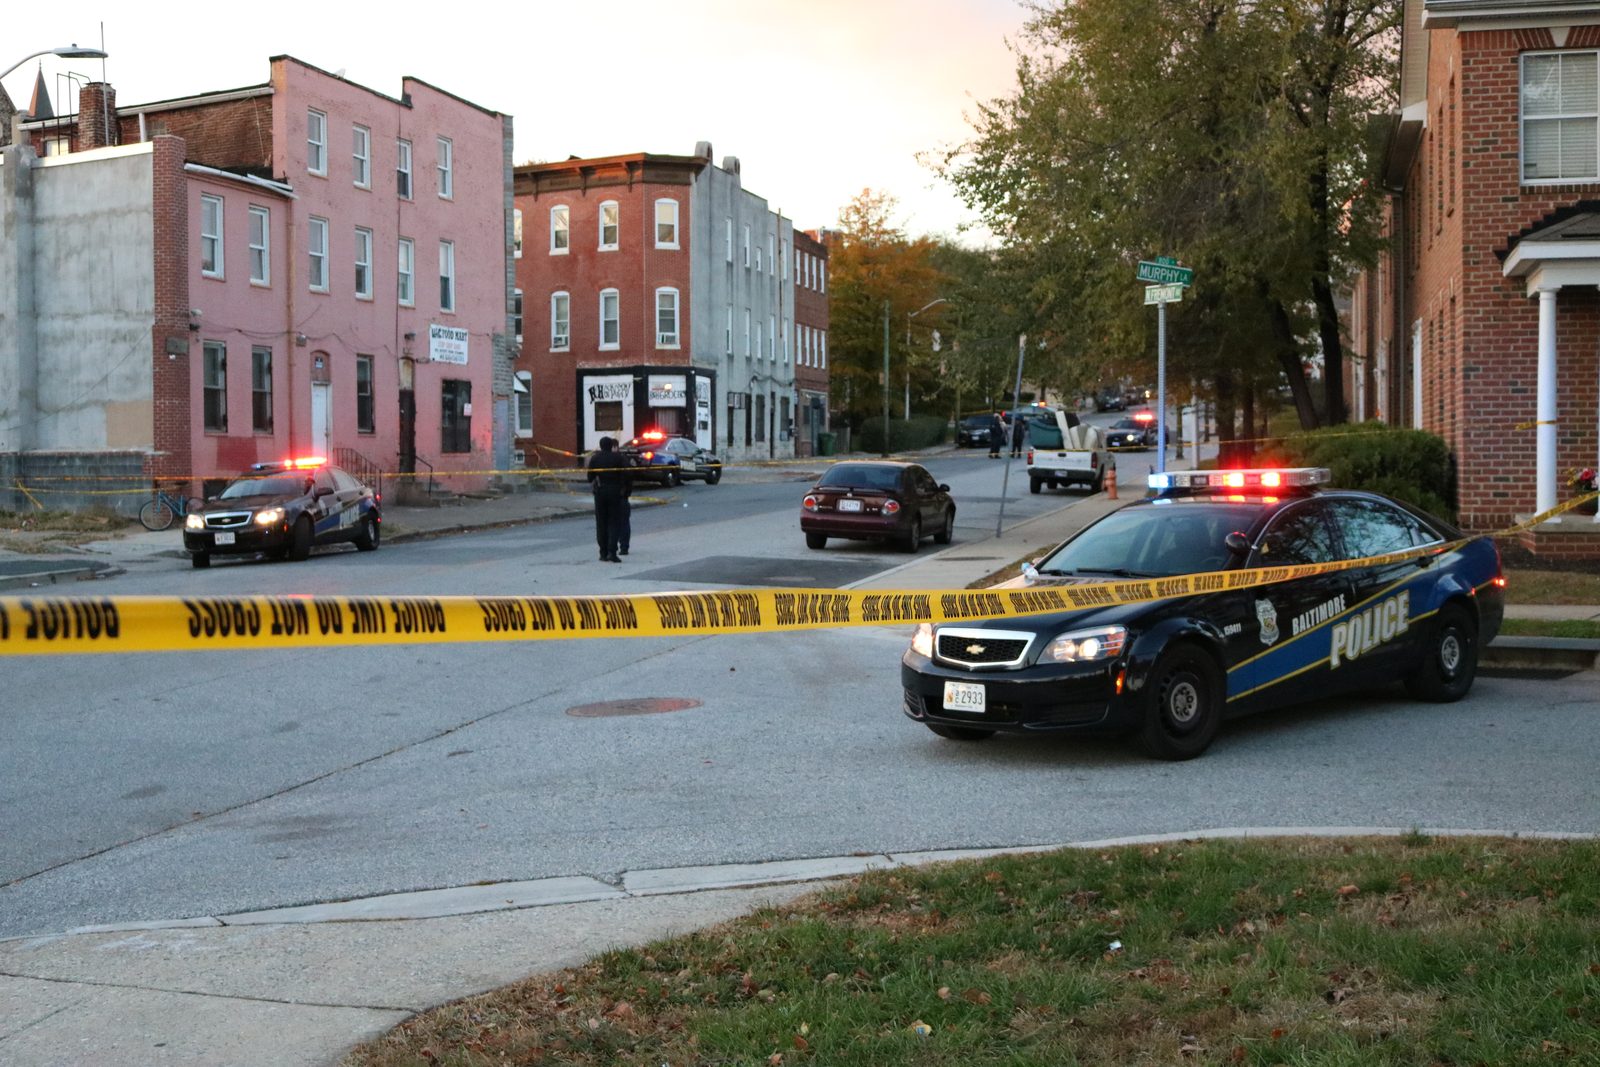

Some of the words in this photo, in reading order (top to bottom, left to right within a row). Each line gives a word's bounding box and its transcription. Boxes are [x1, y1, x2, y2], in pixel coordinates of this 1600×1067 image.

[1140, 264, 1180, 282] MURPHY
[1180, 273, 1188, 281] LA
[442, 329, 454, 340] FOOD
[455, 331, 467, 341] MART
[21, 600, 118, 639] POLICE
[184, 600, 260, 637] CROSS
[268, 600, 309, 636] NOT
[315, 600, 343, 635] DO
[348, 600, 386, 634] LINE
[391, 600, 445, 633] POLICE
[480, 600, 526, 632] CROSS
[526, 599, 556, 631] NOT
[553, 599, 576, 631] DO
[575, 599, 601, 630] LINE
[601, 599, 638, 630] POLICE
[1292, 593, 1346, 636] BALTIMORE
[1330, 589, 1410, 670] POLICE
[961, 690, 983, 705] 2933
